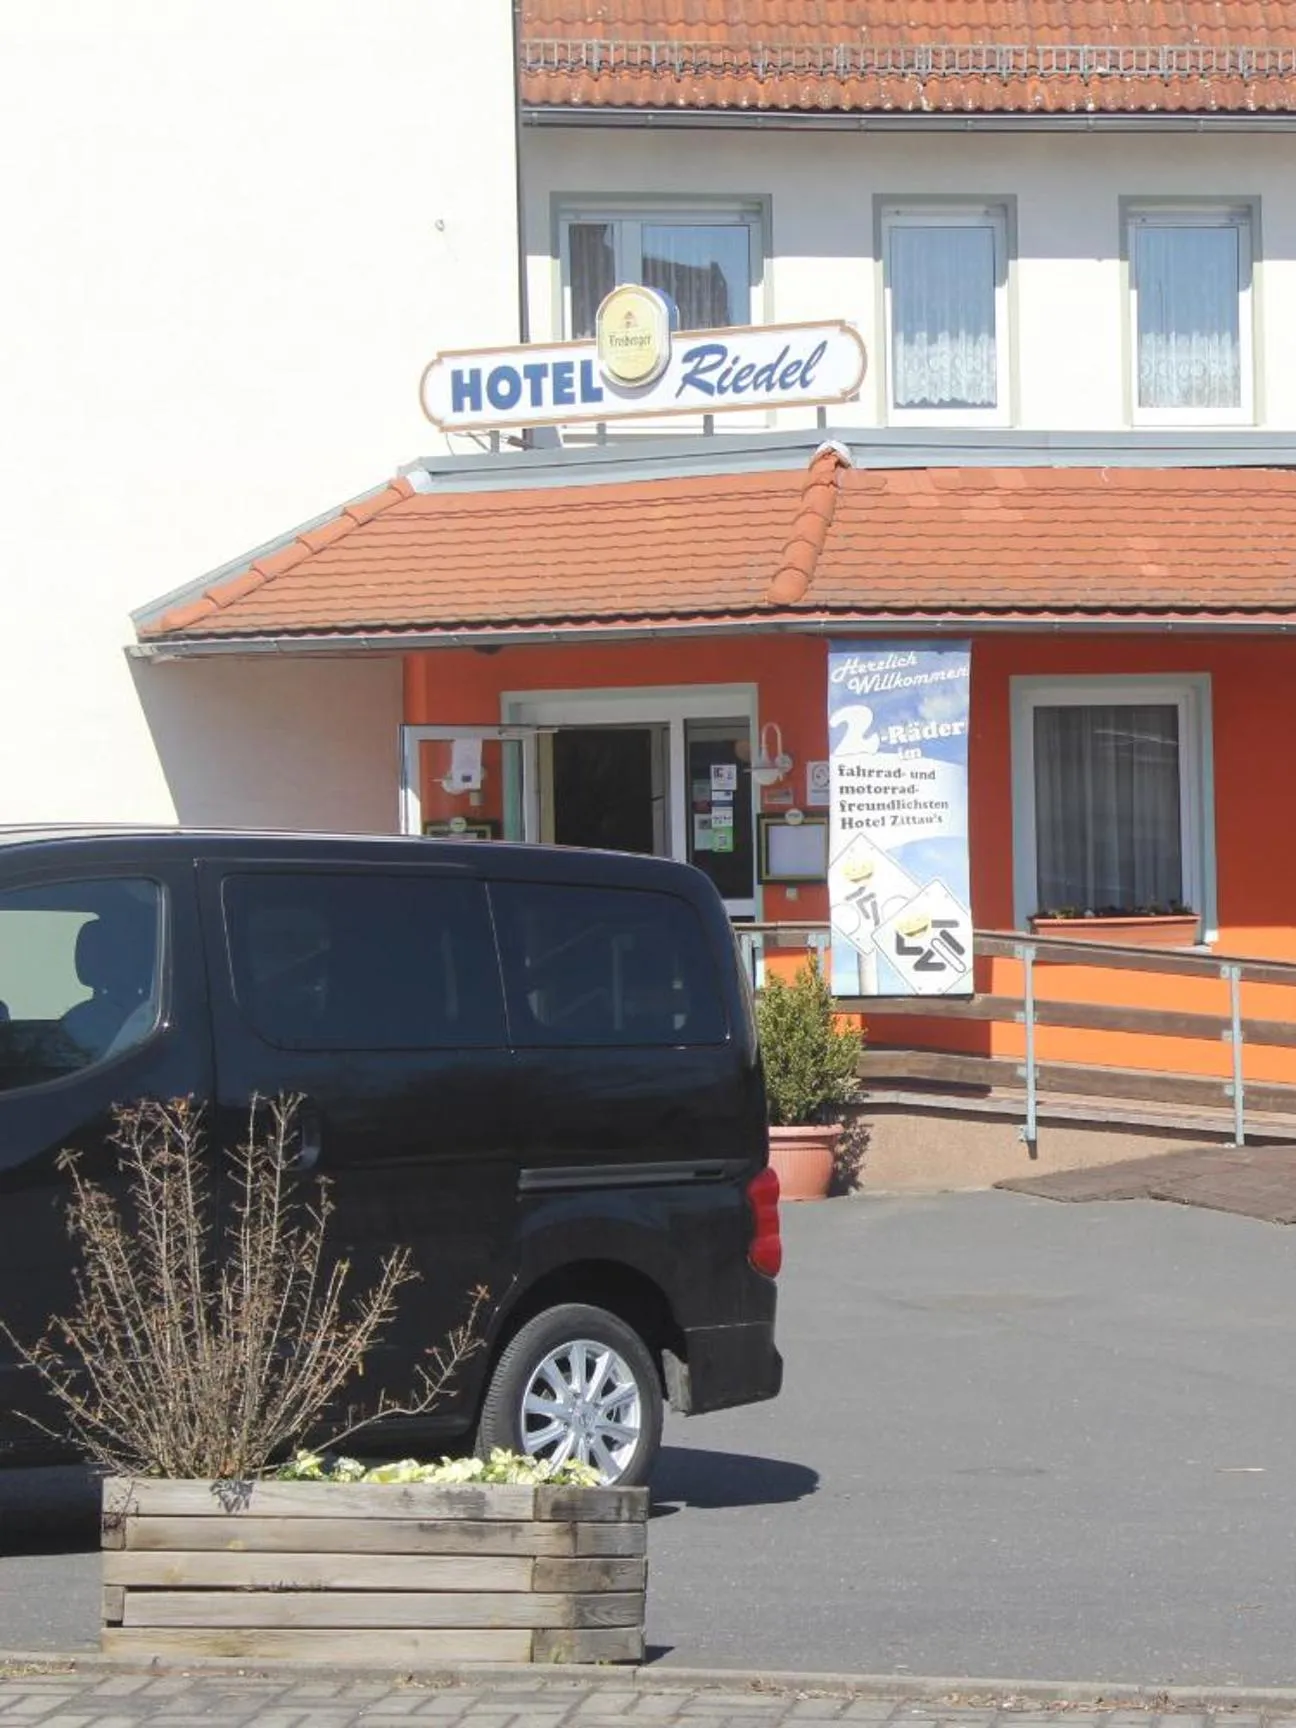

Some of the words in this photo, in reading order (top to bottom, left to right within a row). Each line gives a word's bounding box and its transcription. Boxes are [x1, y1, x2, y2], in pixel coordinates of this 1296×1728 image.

[451, 359, 603, 413] HOTEL
[675, 340, 828, 398] Riedel
[830, 651, 918, 682] Herzlich
[847, 665, 969, 695] Willkommen
[838, 764, 906, 779] fahrrad-
[909, 769, 936, 781] und
[839, 784, 919, 796] motorrad-
[839, 800, 949, 812] freundlichsten
[840, 815, 886, 830] Hotel
